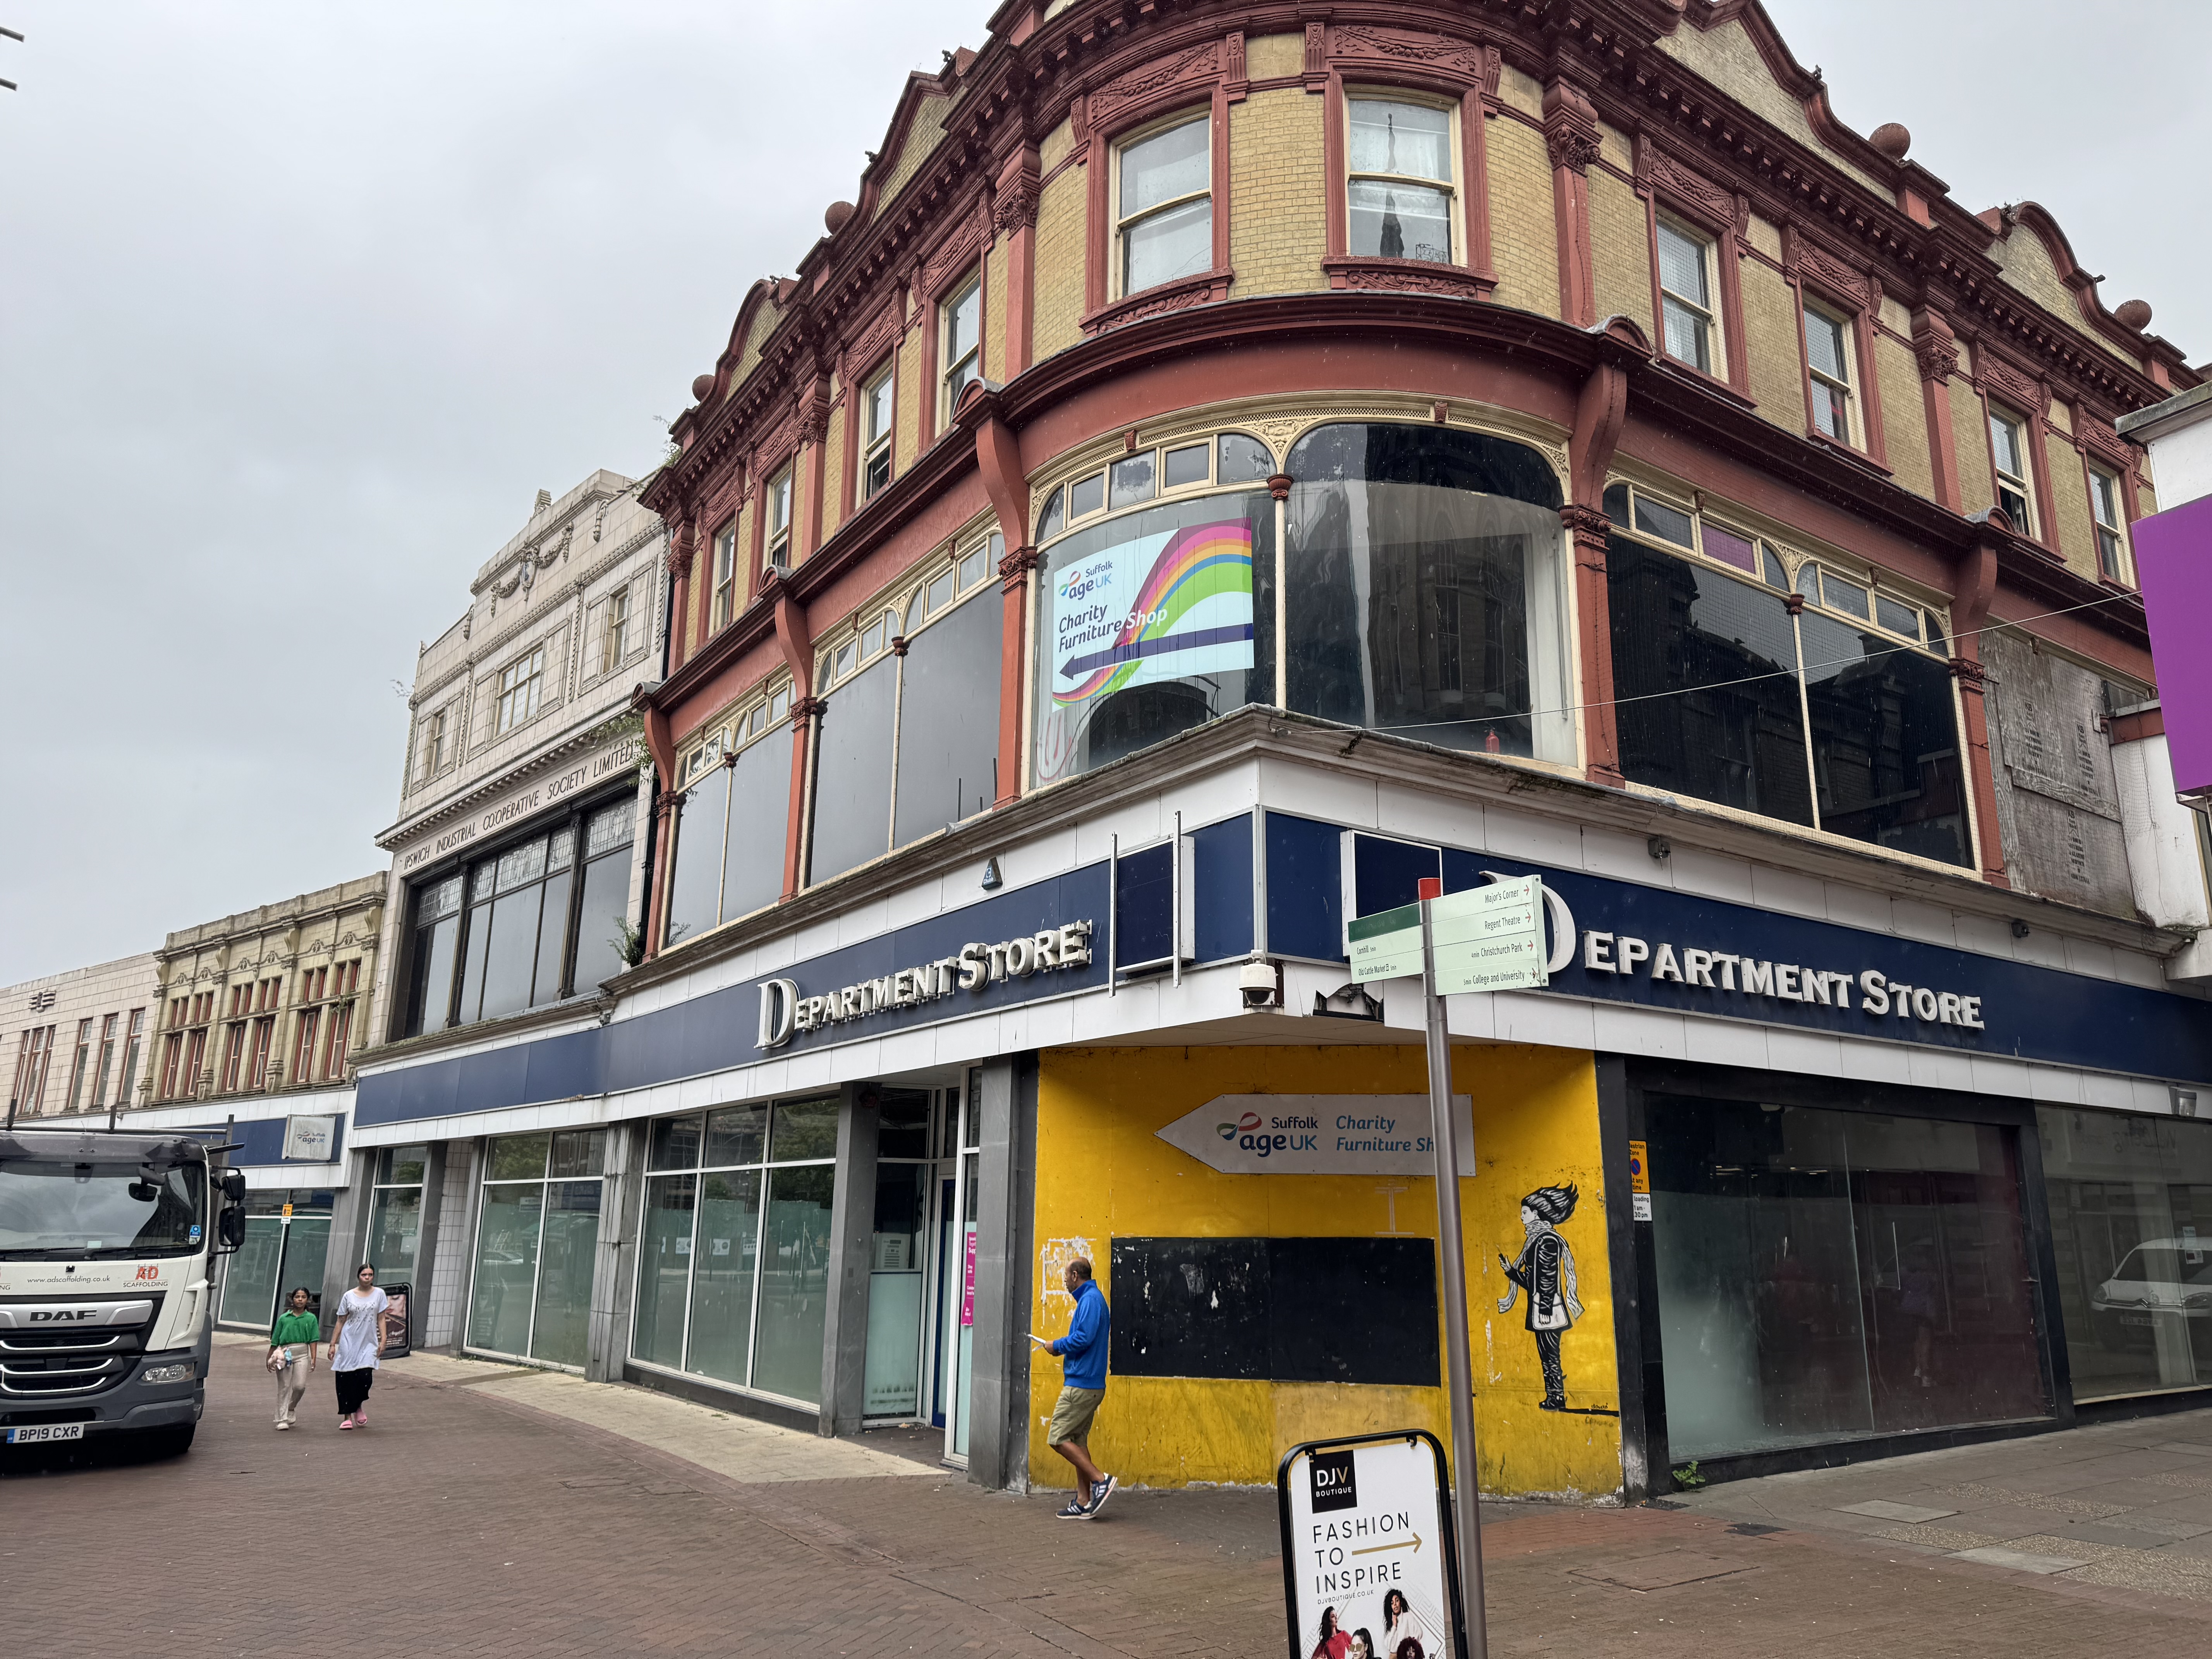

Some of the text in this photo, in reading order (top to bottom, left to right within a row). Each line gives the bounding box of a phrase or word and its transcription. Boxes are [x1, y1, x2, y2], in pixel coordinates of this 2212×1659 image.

[1085, 560, 1113, 578] Suffolk
[1059, 605, 1108, 633] Charity
[1059, 608, 1167, 653] Furniture Shop
[2025, 702, 2032, 711] KB
[2077, 724, 2084, 733] KB
[404, 845, 430, 870] IPSWICH
[436, 822, 476, 854] INDUSTRIAL
[547, 766, 587, 800] SOCIETY
[594, 745, 633, 778] LIMITED
[2068, 810, 2075, 819] KB
[1485, 890, 1518, 903] Major's Corner
[1485, 916, 1520, 930] Regent Theatre
[1357, 945, 1369, 955] Cornhill
[1481, 944, 1510, 957] Christchurch
[1511, 942, 1523, 953] Park
[1374, 965, 1386, 973] Market
[1473, 974, 1489, 985] College
[1491, 972, 1499, 982] and
[1500, 970, 1525, 981] University
[1271, 1116, 1318, 1129] Suffolk
[1336, 1115, 1395, 1133] Charity
[1336, 1137, 1434, 1151] Furniture Sh
[29, 1310, 97, 1322] DAF
[19, 1426, 79, 1441] BP19 CXR
[1317, 1466, 1348, 1487] DJV
[1316, 1487, 1352, 1497] BOUTIQUE
[1313, 1511, 1409, 1544] FASHION
[1315, 1547, 1343, 1568] TO
[1316, 1561, 1401, 1594] INSPIRE
[1317, 1590, 1374, 1604] DJVBOUTIQUE.CO.UK
